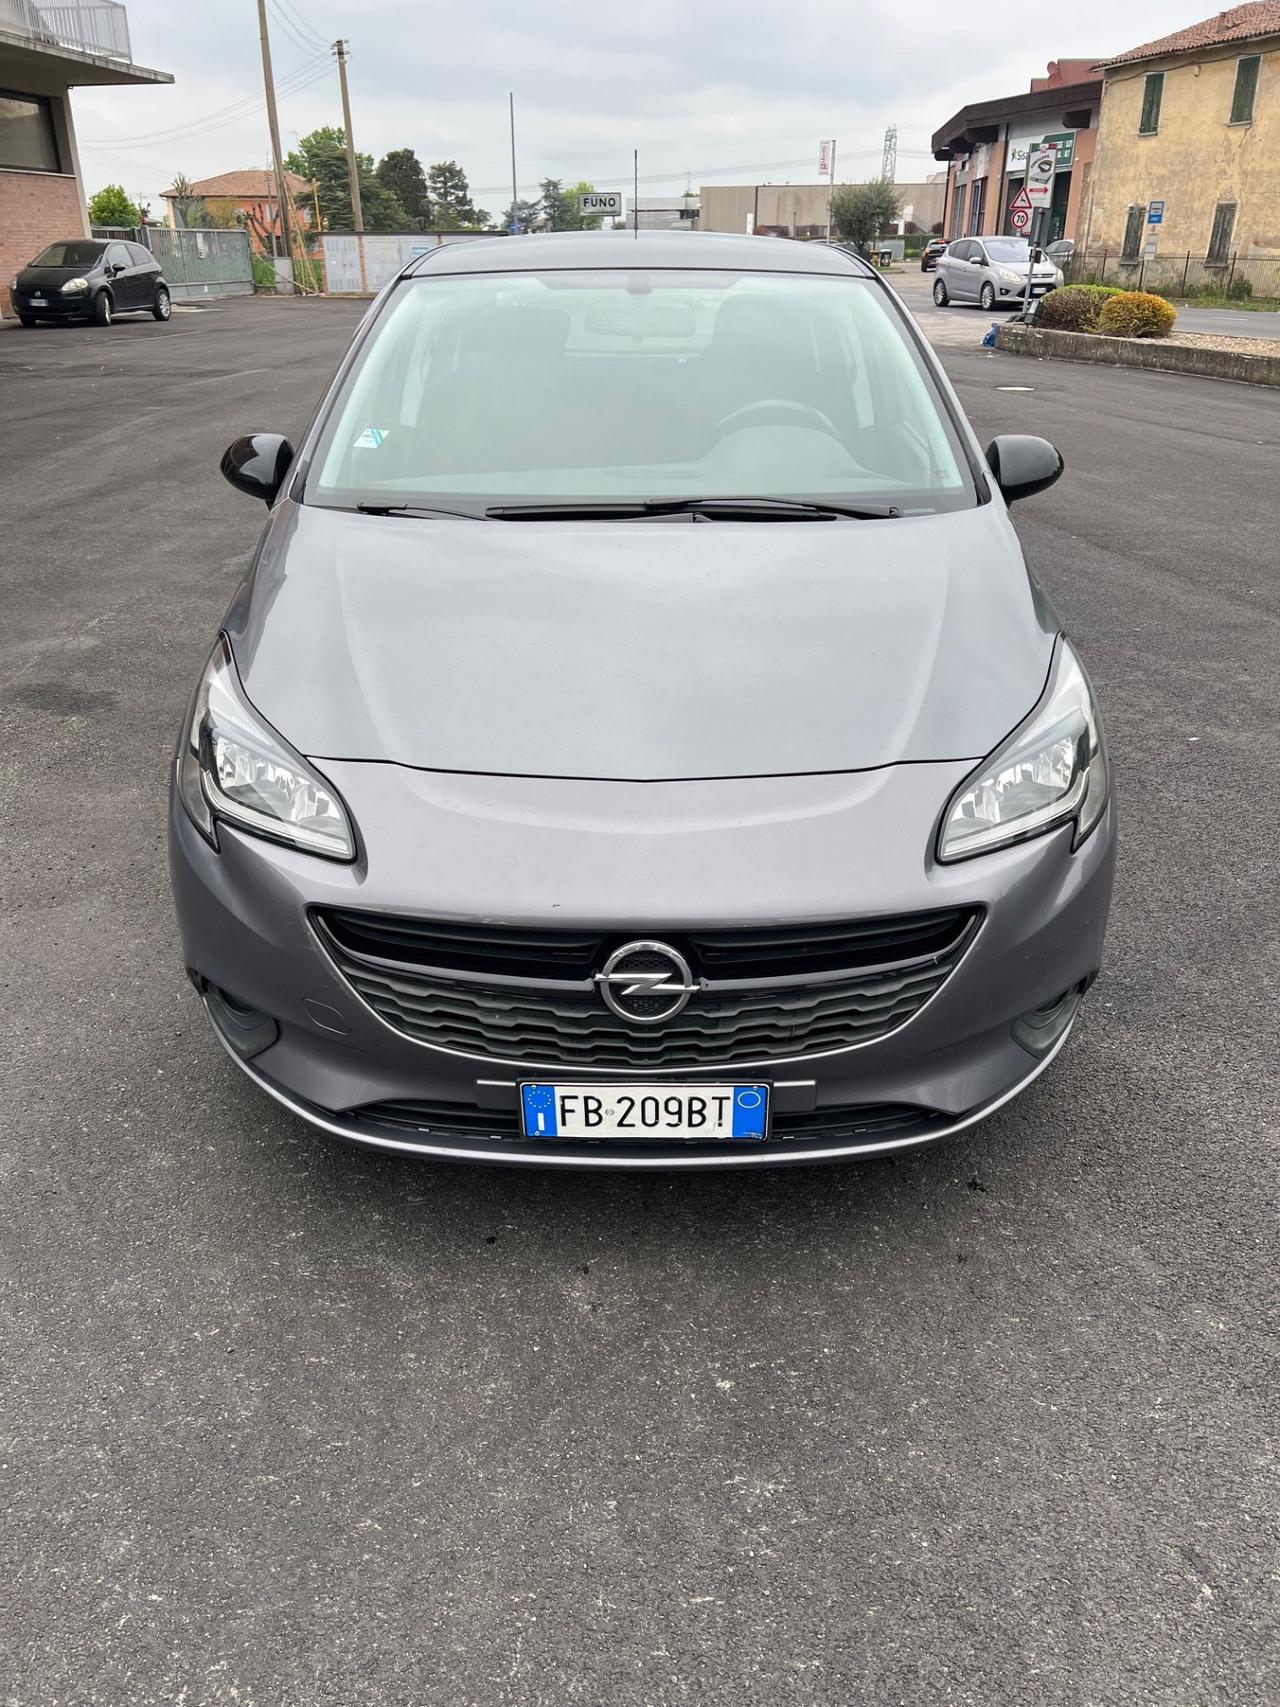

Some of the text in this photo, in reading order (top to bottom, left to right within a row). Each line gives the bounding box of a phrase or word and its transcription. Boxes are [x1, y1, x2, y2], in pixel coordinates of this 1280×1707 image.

[583, 197, 616, 207] FUNO
[1016, 214, 1025, 224] 70
[559, 1095, 731, 1128] FB 209BT
